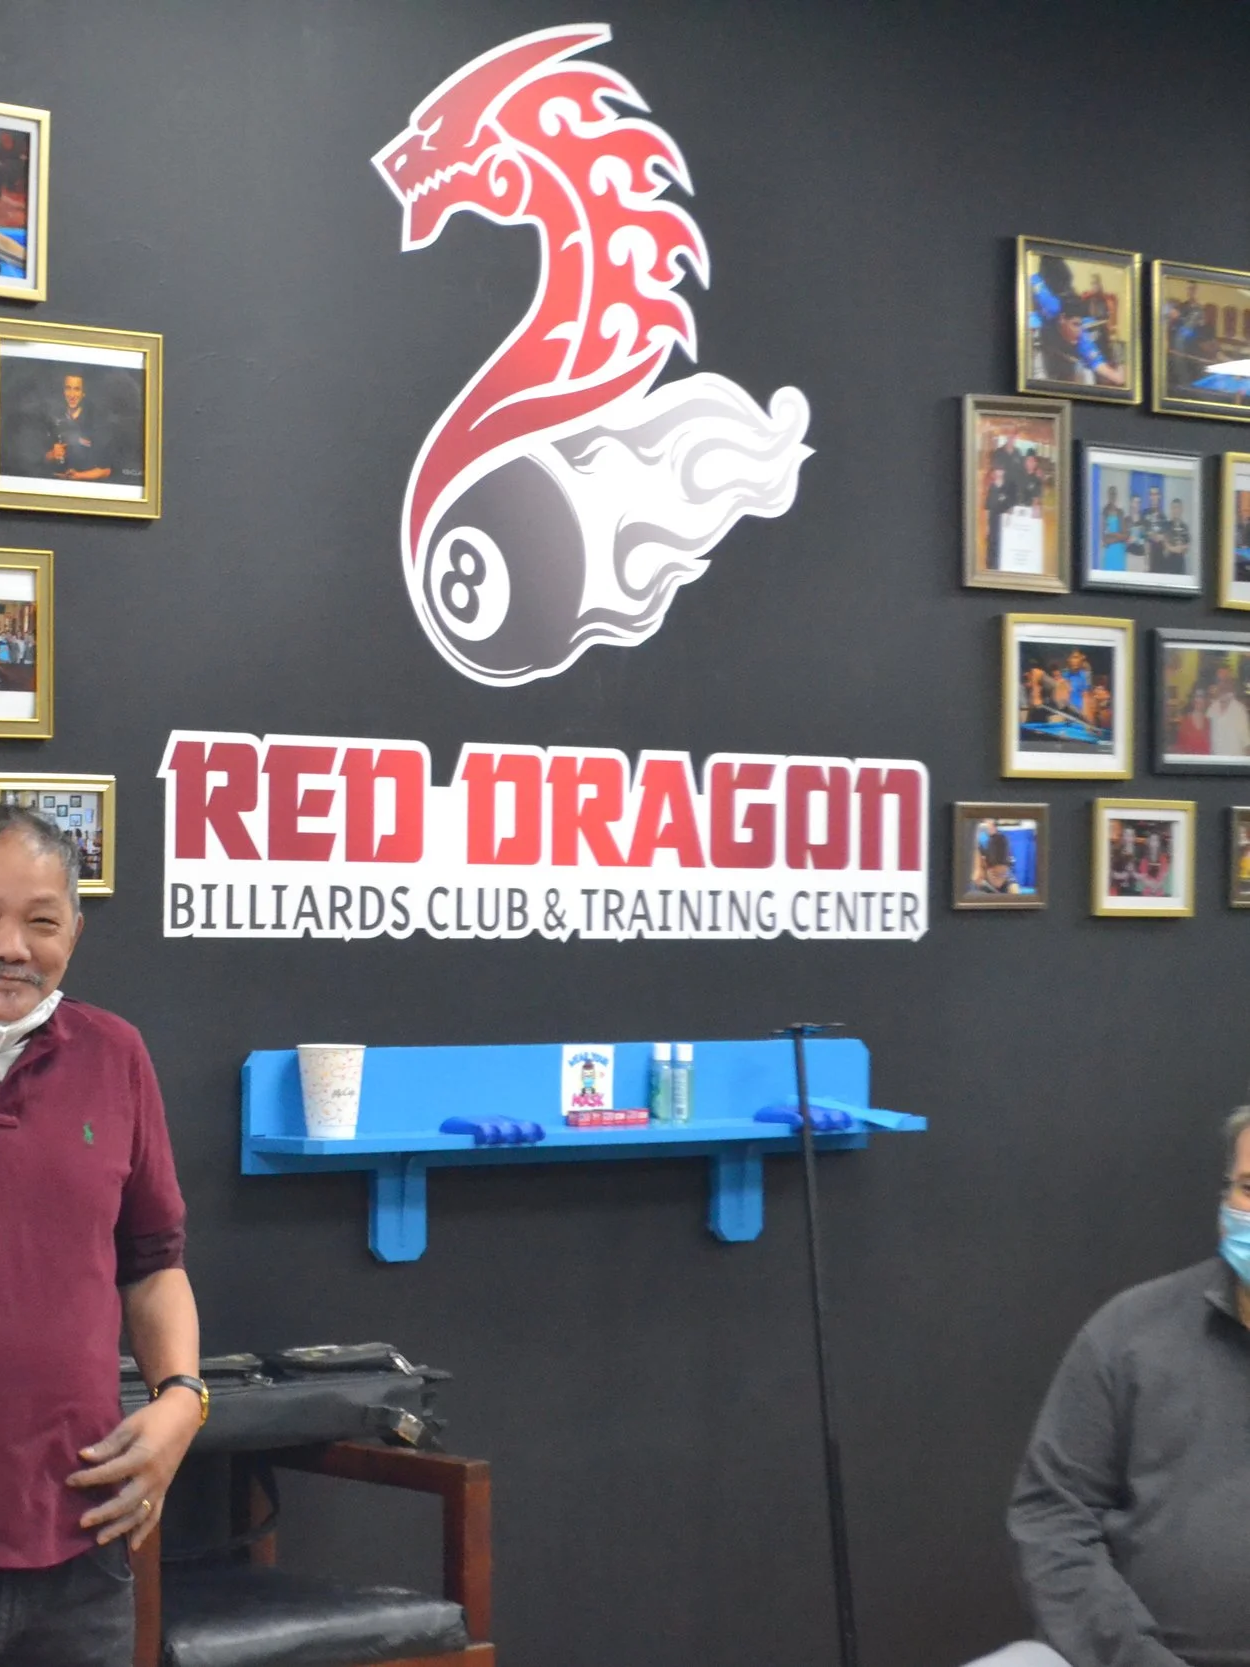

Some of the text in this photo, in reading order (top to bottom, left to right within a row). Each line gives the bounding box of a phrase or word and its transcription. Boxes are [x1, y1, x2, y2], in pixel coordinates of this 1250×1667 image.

[440, 538, 487, 624] 8
[167, 740, 922, 871] RED DRAGON
[169, 882, 920, 933] BILLIARDS CLUB & TRAINING CENTER
